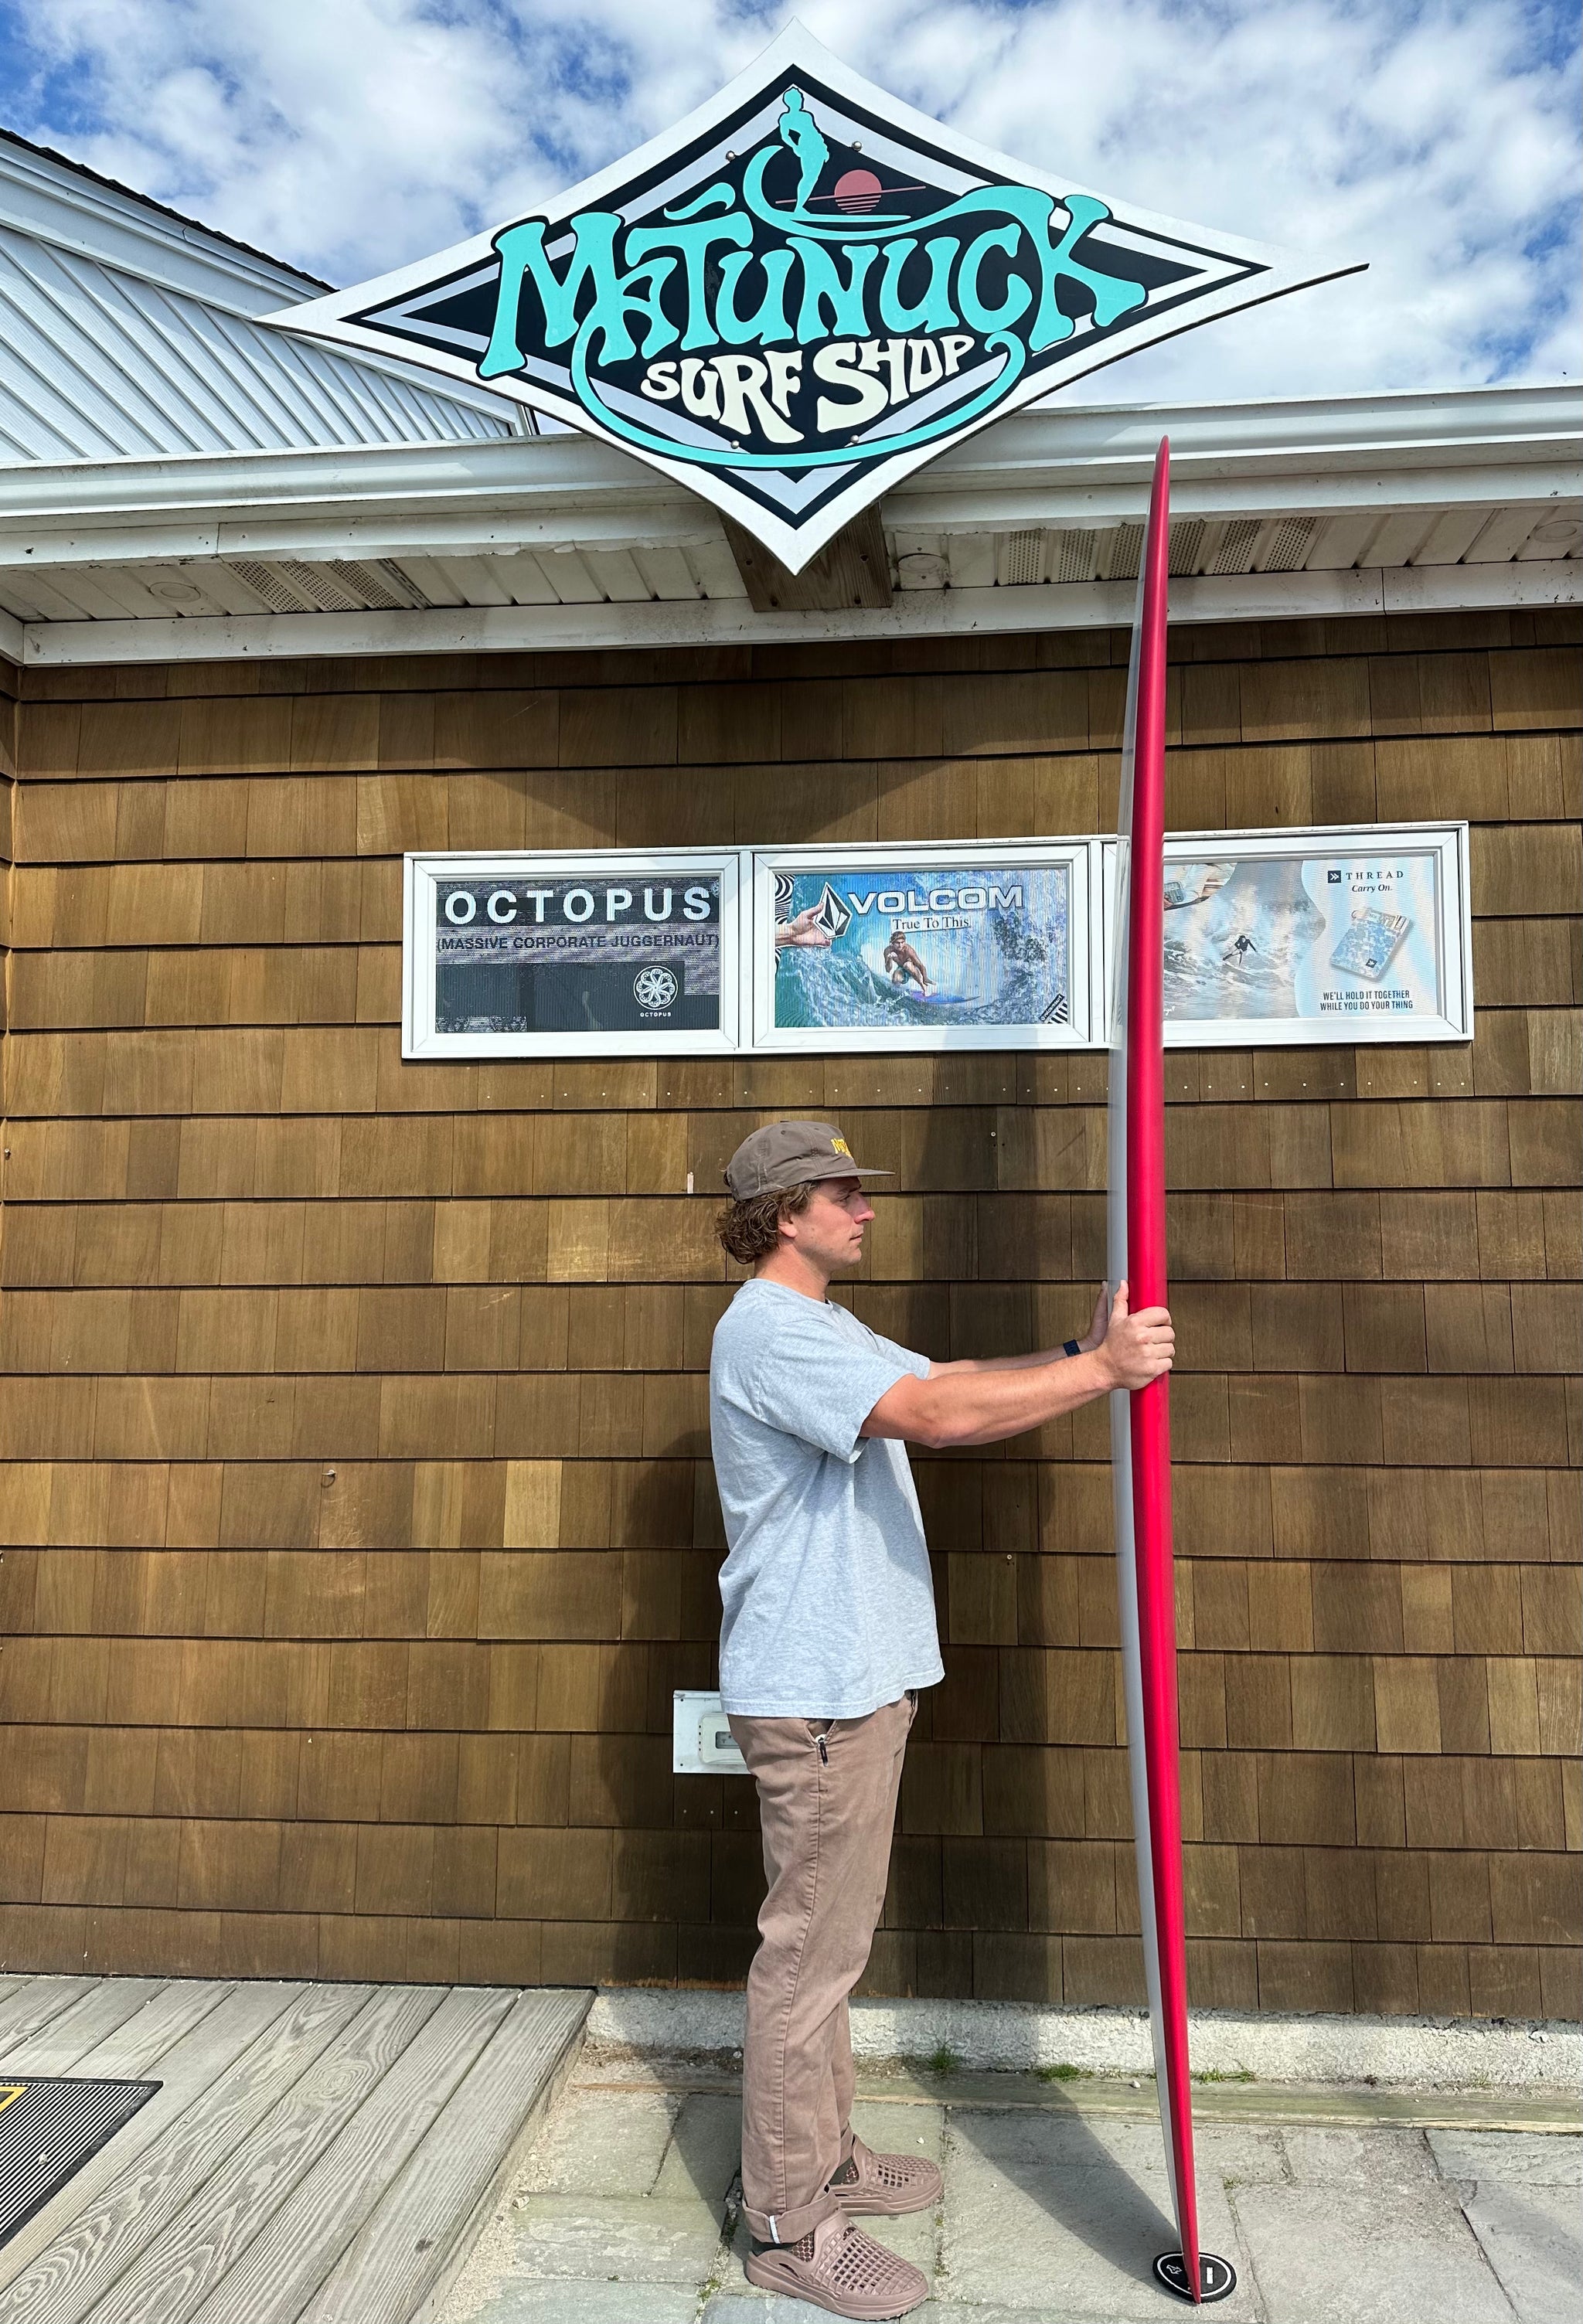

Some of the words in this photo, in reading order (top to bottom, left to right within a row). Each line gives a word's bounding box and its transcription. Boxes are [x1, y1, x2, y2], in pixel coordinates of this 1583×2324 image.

[641, 349, 805, 444] SURF
[813, 335, 975, 433] SHOP
[1346, 870, 1404, 880] THREAD
[1352, 884, 1376, 893] Carry
[444, 886, 711, 924] OCTOPUS
[847, 885, 1023, 915] VOLCOM
[892, 918, 921, 930] True
[923, 917, 940, 929] To
[943, 916, 969, 928] This
[437, 936, 508, 953] (MASSIVE
[513, 935, 606, 949] CORPORATE
[1323, 991, 1344, 1001] WE'LL
[1346, 991, 1364, 1000] HOLD
[1366, 990, 1373, 999] IT
[1374, 989, 1410, 999] TOGETHER
[1320, 1002, 1343, 1011] WHILE
[1344, 1001, 1358, 1010] YOU
[1360, 1001, 1370, 1010] DO
[1371, 1000, 1390, 1009] YOUR
[1391, 1000, 1413, 1009] THING
